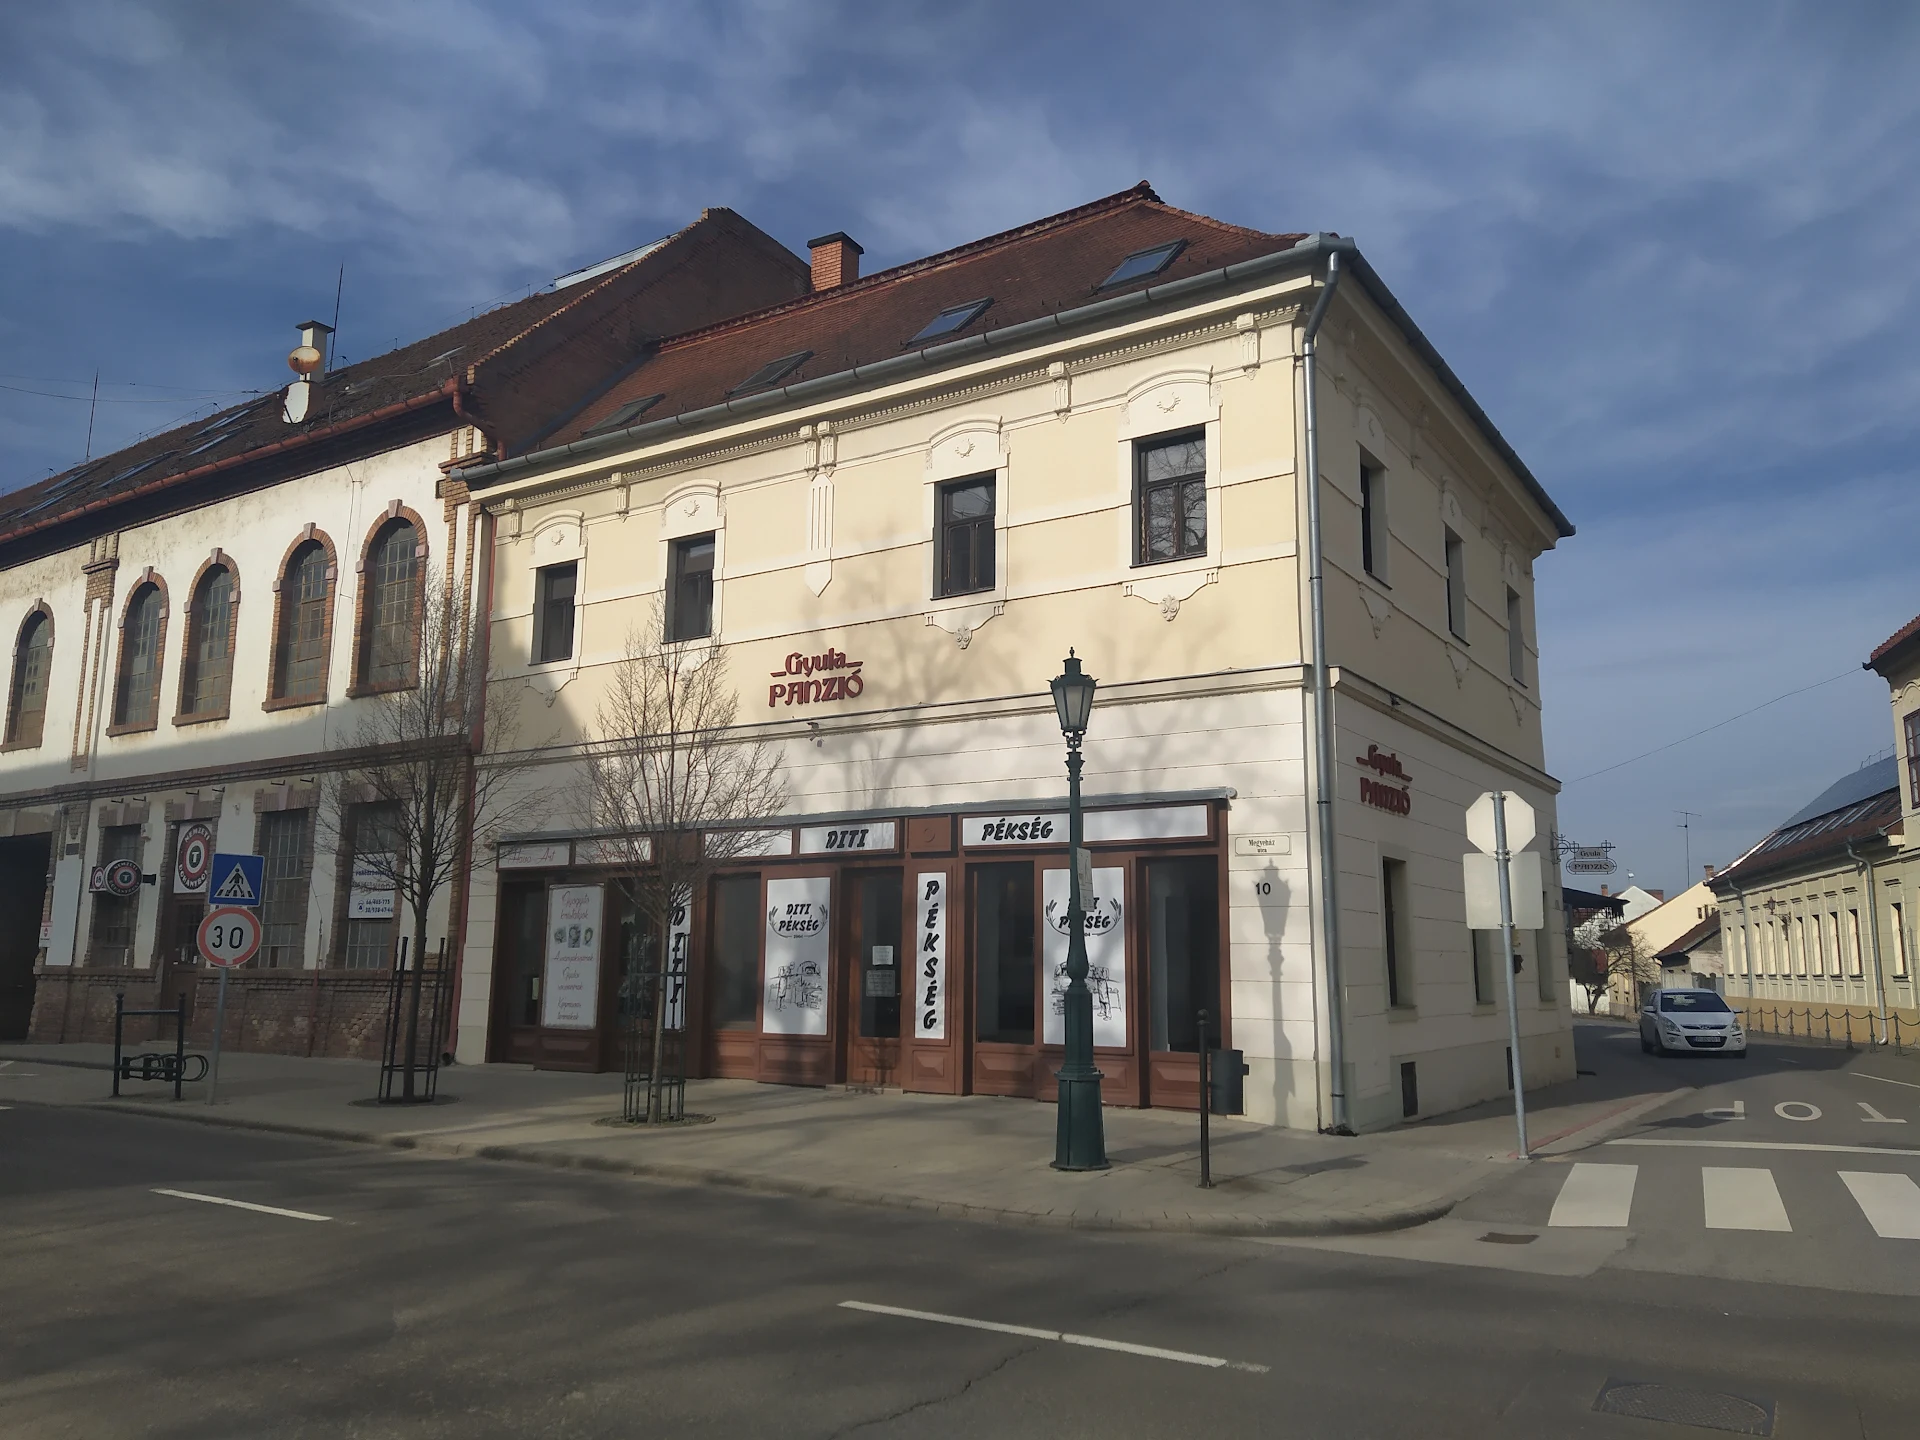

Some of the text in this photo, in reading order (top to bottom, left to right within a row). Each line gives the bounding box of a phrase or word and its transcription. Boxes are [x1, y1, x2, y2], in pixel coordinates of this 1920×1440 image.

[769, 647, 864, 678] Gyula
[768, 668, 864, 708] PANZIÓ
[185, 827, 211, 842] NEMZETI
[981, 816, 1054, 841] PÉKSÉG
[825, 829, 869, 849] DITI
[192, 851, 200, 863] T
[1255, 882, 1271, 896] 10
[786, 903, 812, 915] DITI
[778, 915, 820, 931] PÉKSÉG
[1059, 910, 1111, 929] PSÉG
[212, 925, 244, 949] 30
[923, 880, 940, 1030] PÉKSÉG
[1703, 1100, 1920, 1124] TOP
